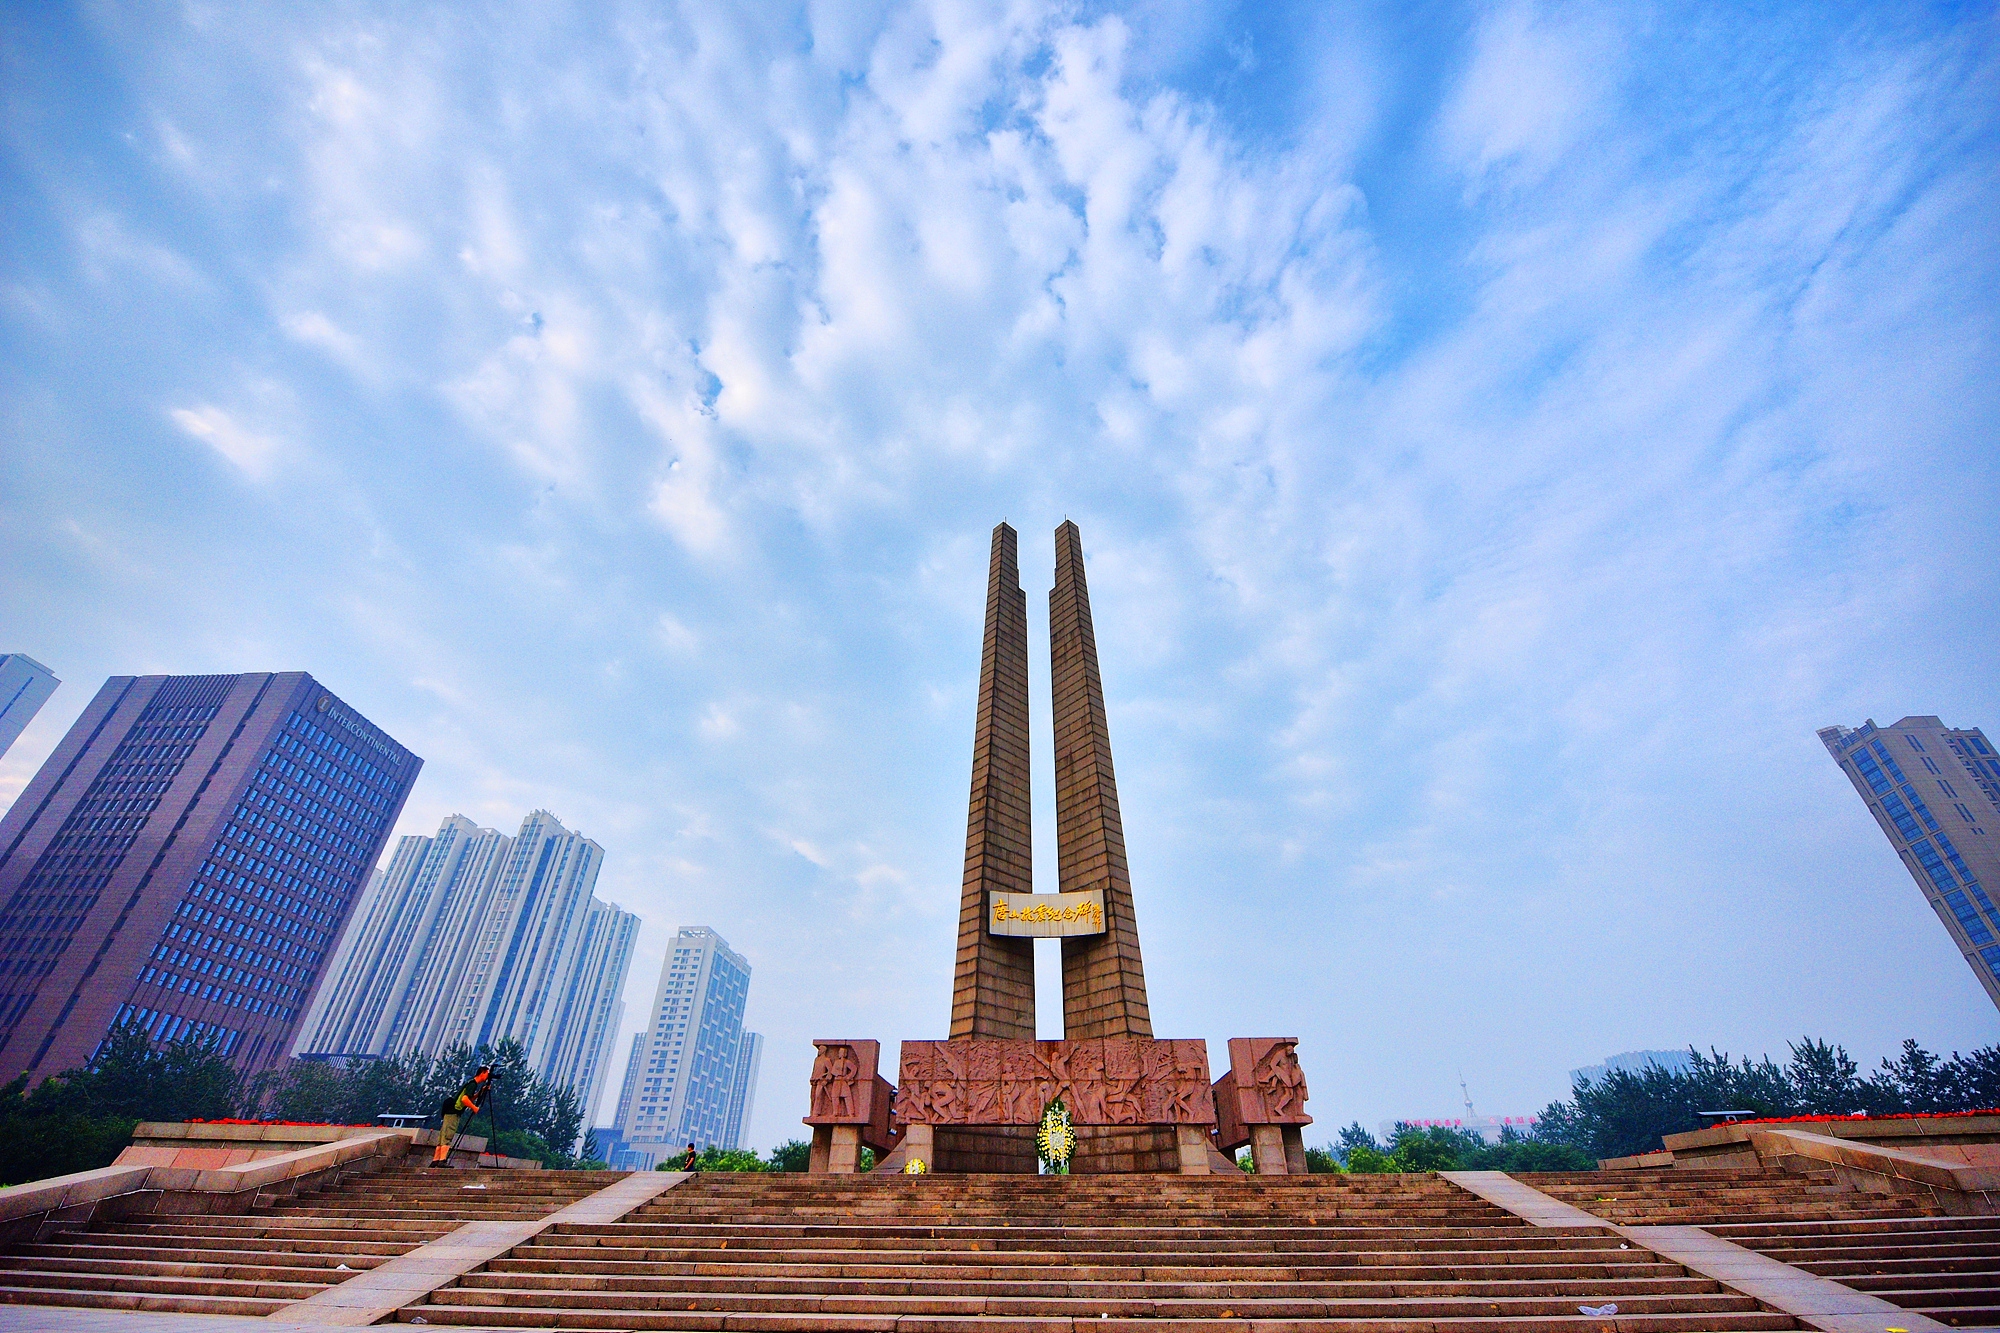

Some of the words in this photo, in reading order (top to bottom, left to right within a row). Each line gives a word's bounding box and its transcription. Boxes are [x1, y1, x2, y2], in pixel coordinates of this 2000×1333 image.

[992, 898, 1092, 926] 唐山抗震纪念碑
